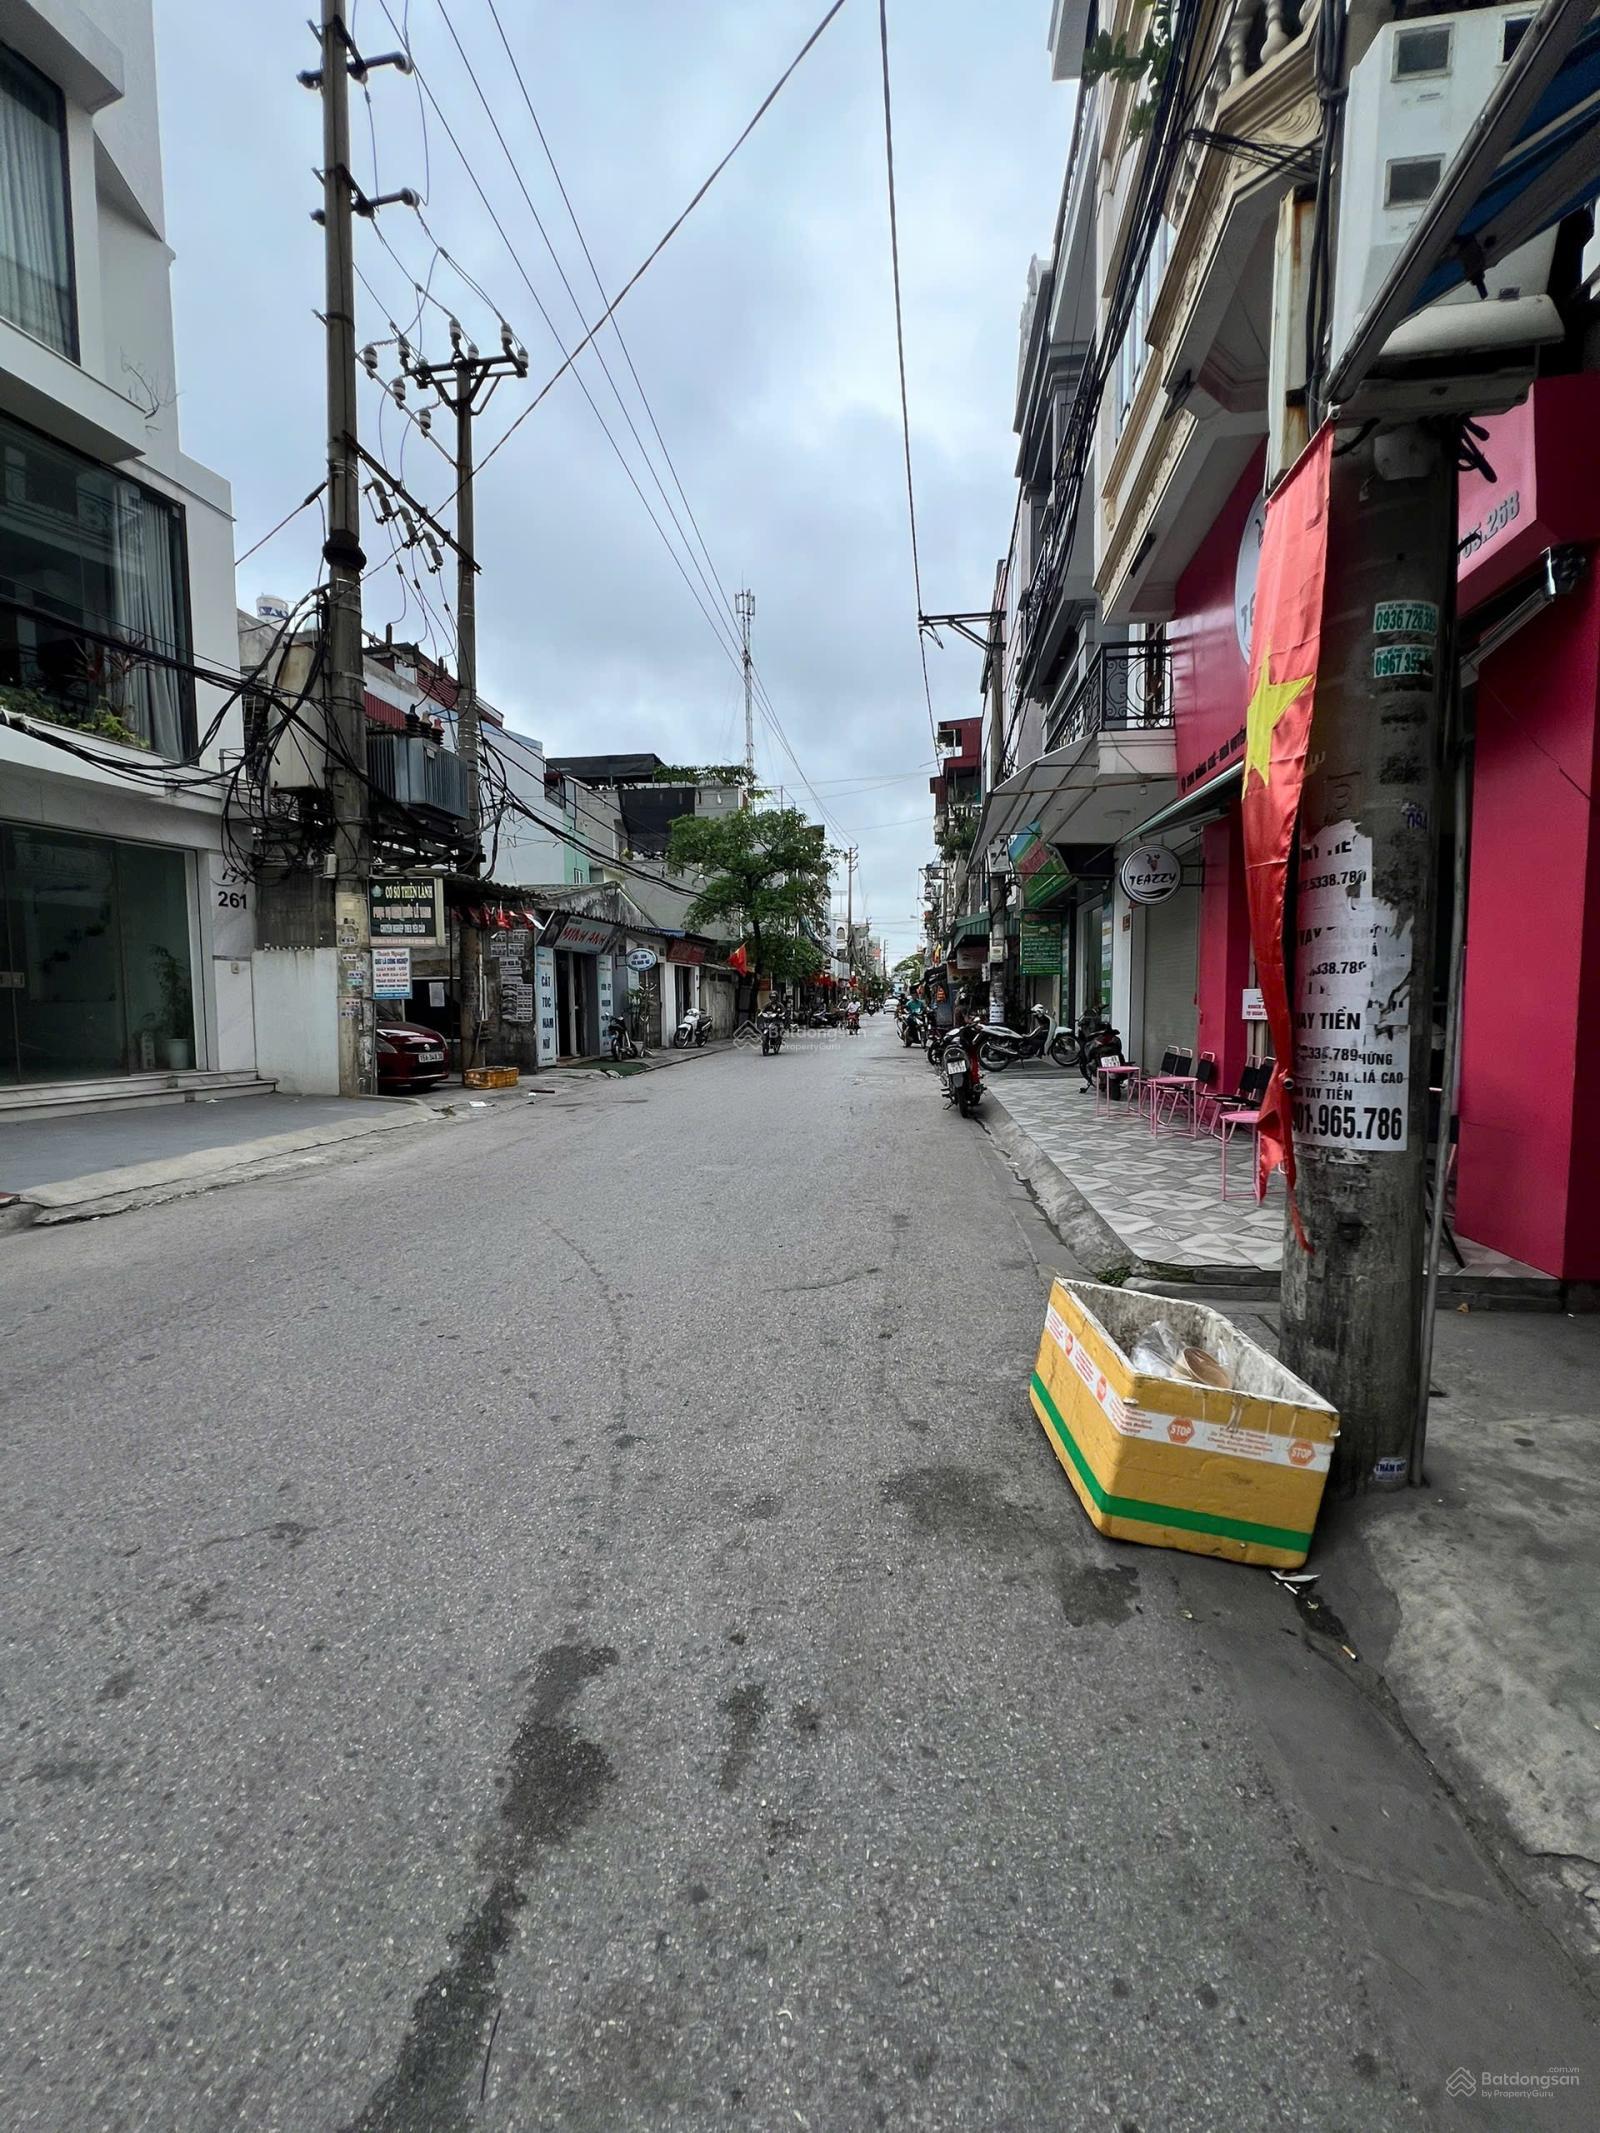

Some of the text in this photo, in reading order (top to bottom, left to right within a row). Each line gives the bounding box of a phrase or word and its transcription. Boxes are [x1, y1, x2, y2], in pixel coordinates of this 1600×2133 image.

[1129, 873, 1177, 887] TEAZZY
[218, 891, 247, 909] 261
[1381, 1072, 1404, 1084] CAO
[1170, 1428, 1192, 1437] STOP
[1291, 1448, 1313, 1458] STOP
